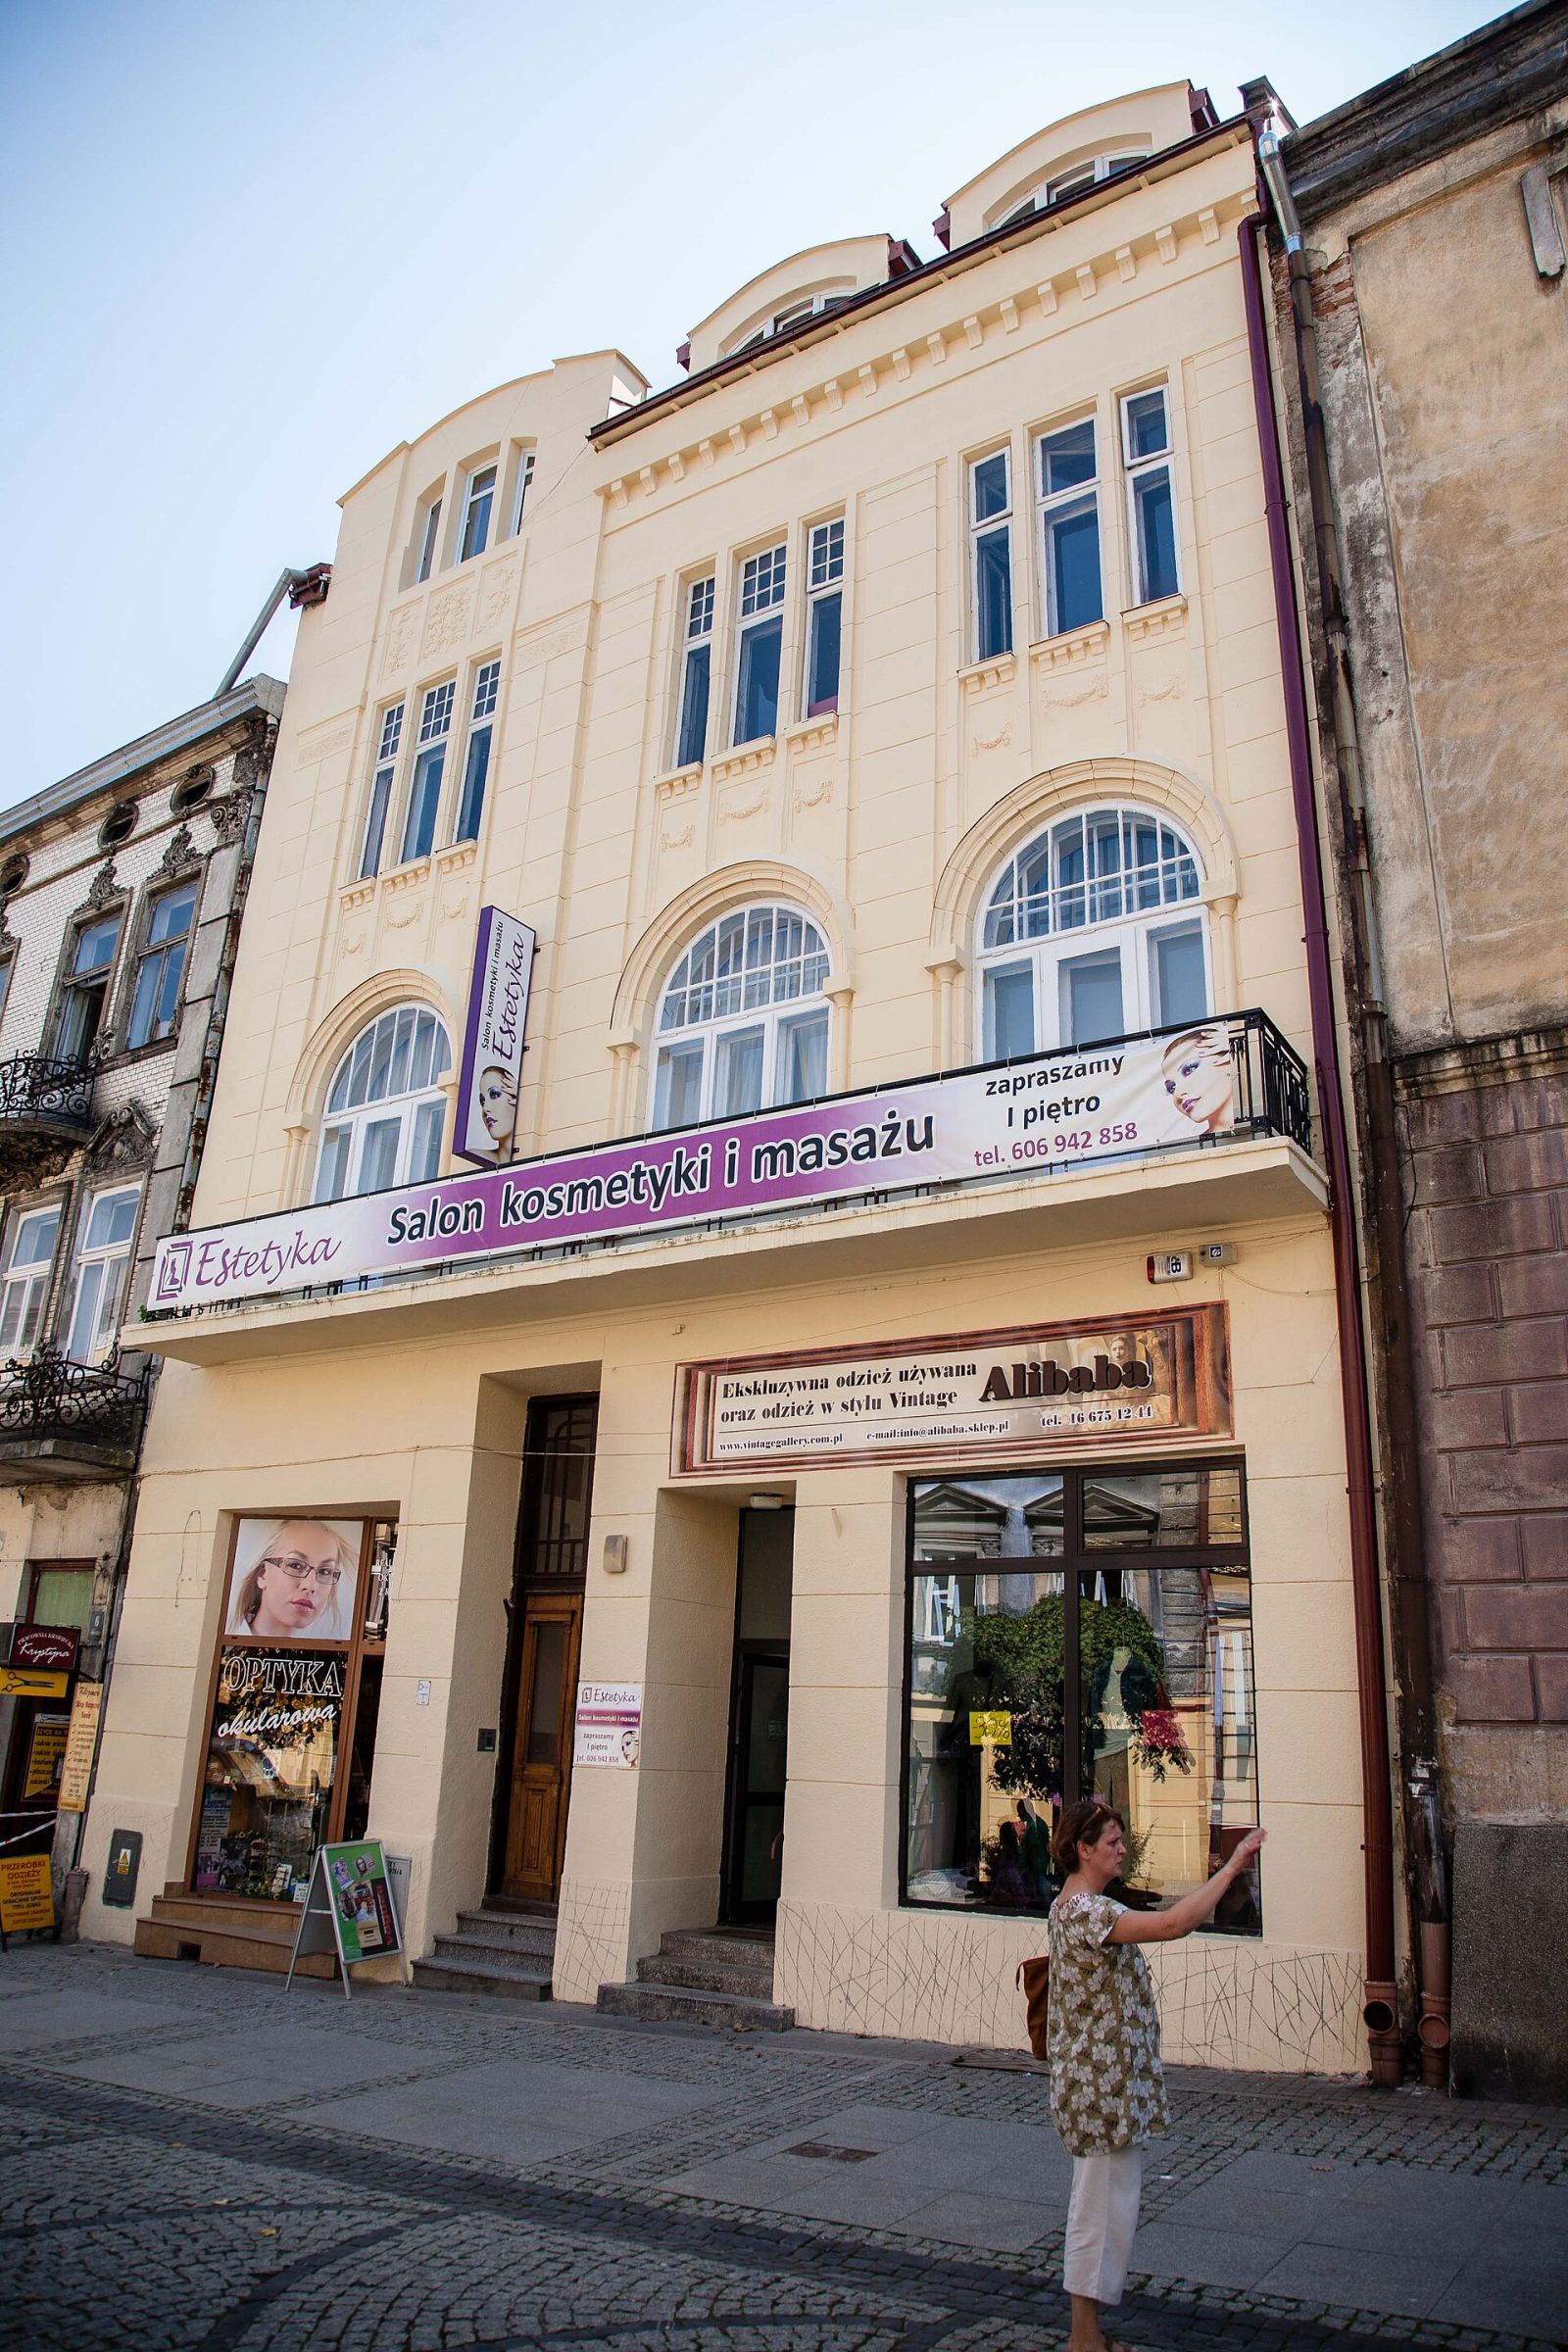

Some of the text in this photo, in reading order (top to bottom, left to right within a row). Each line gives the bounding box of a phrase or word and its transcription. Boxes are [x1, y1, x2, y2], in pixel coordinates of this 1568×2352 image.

[494, 921, 504, 959] masażu
[485, 965, 498, 1017] kosmetyki
[492, 932, 524, 1060] Estetyka
[481, 1022, 492, 1051] Salon
[985, 1054, 1125, 1096] zapraszamy
[1007, 1095, 1101, 1130] I piętro
[974, 1122, 1138, 1166] tel. 606 942 858
[386, 1108, 934, 1245] Salon kosmetyki i masażu
[195, 1229, 342, 1287] Estetyka
[722, 1362, 977, 1398] Ekskluzywna odzież używana
[978, 1354, 1152, 1402] Alibaba
[721, 1390, 958, 1423] oraz odzież w stylu Vintage
[719, 1433, 843, 1451] www.vintagegallery.com.pl
[1041, 1415, 1061, 1427] tel.
[1088, 1409, 1111, 1423] 675
[1116, 1408, 1131, 1420] 12
[20, 1642, 70, 1664] Krystyna
[223, 1656, 342, 1697] OPTYKA
[594, 1688, 638, 1704] Estetyka
[218, 1704, 337, 1738] okularowa
[590, 1742, 608, 1751] piętro
